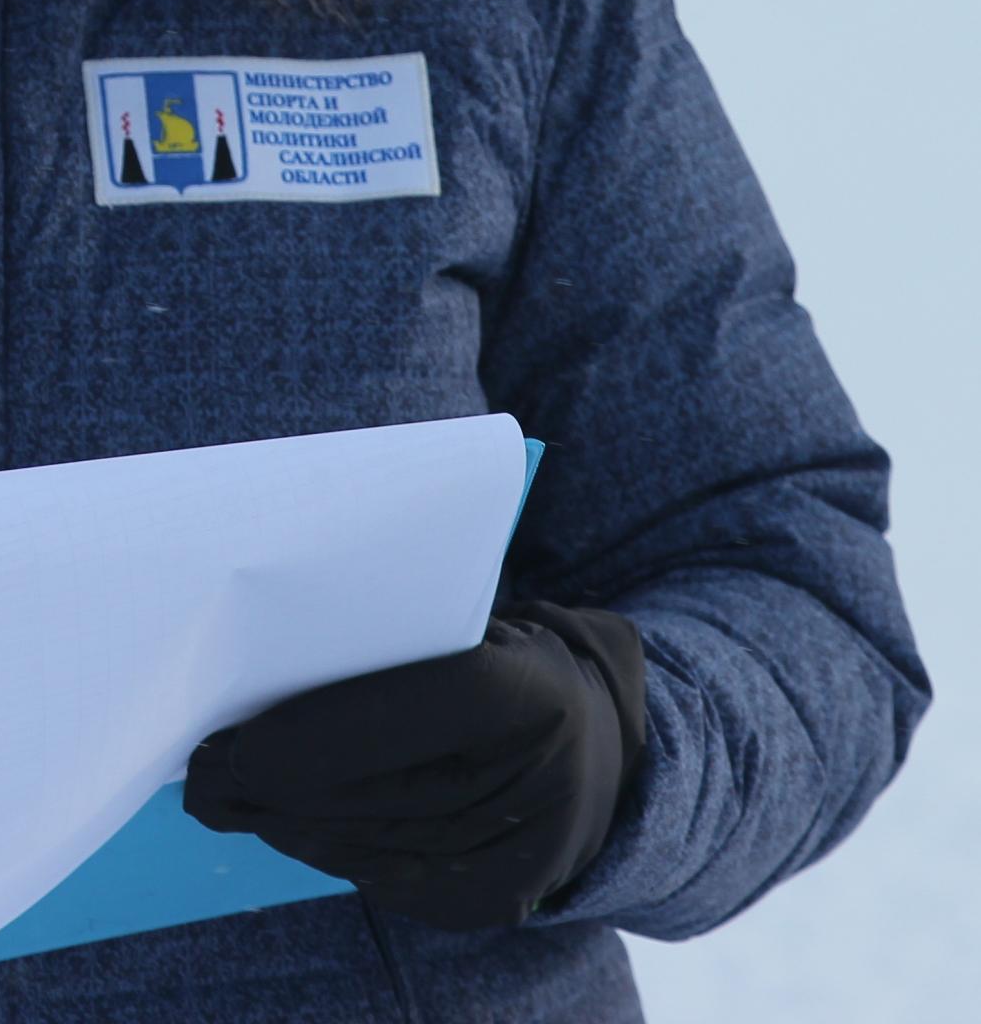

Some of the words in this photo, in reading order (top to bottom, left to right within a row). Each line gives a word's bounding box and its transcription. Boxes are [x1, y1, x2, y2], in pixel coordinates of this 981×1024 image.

[245, 71, 392, 90] МИНИСТЕРСТВО
[248, 92, 319, 109] СПОРТА
[324, 96, 338, 110] И
[250, 107, 388, 128] МОЛОДЕЖНОЙ
[252, 130, 357, 148] ПОЛИТИКИ
[279, 142, 422, 166] САХАЛИНСКОЙ
[281, 169, 367, 185] ОБЛАСТИ
